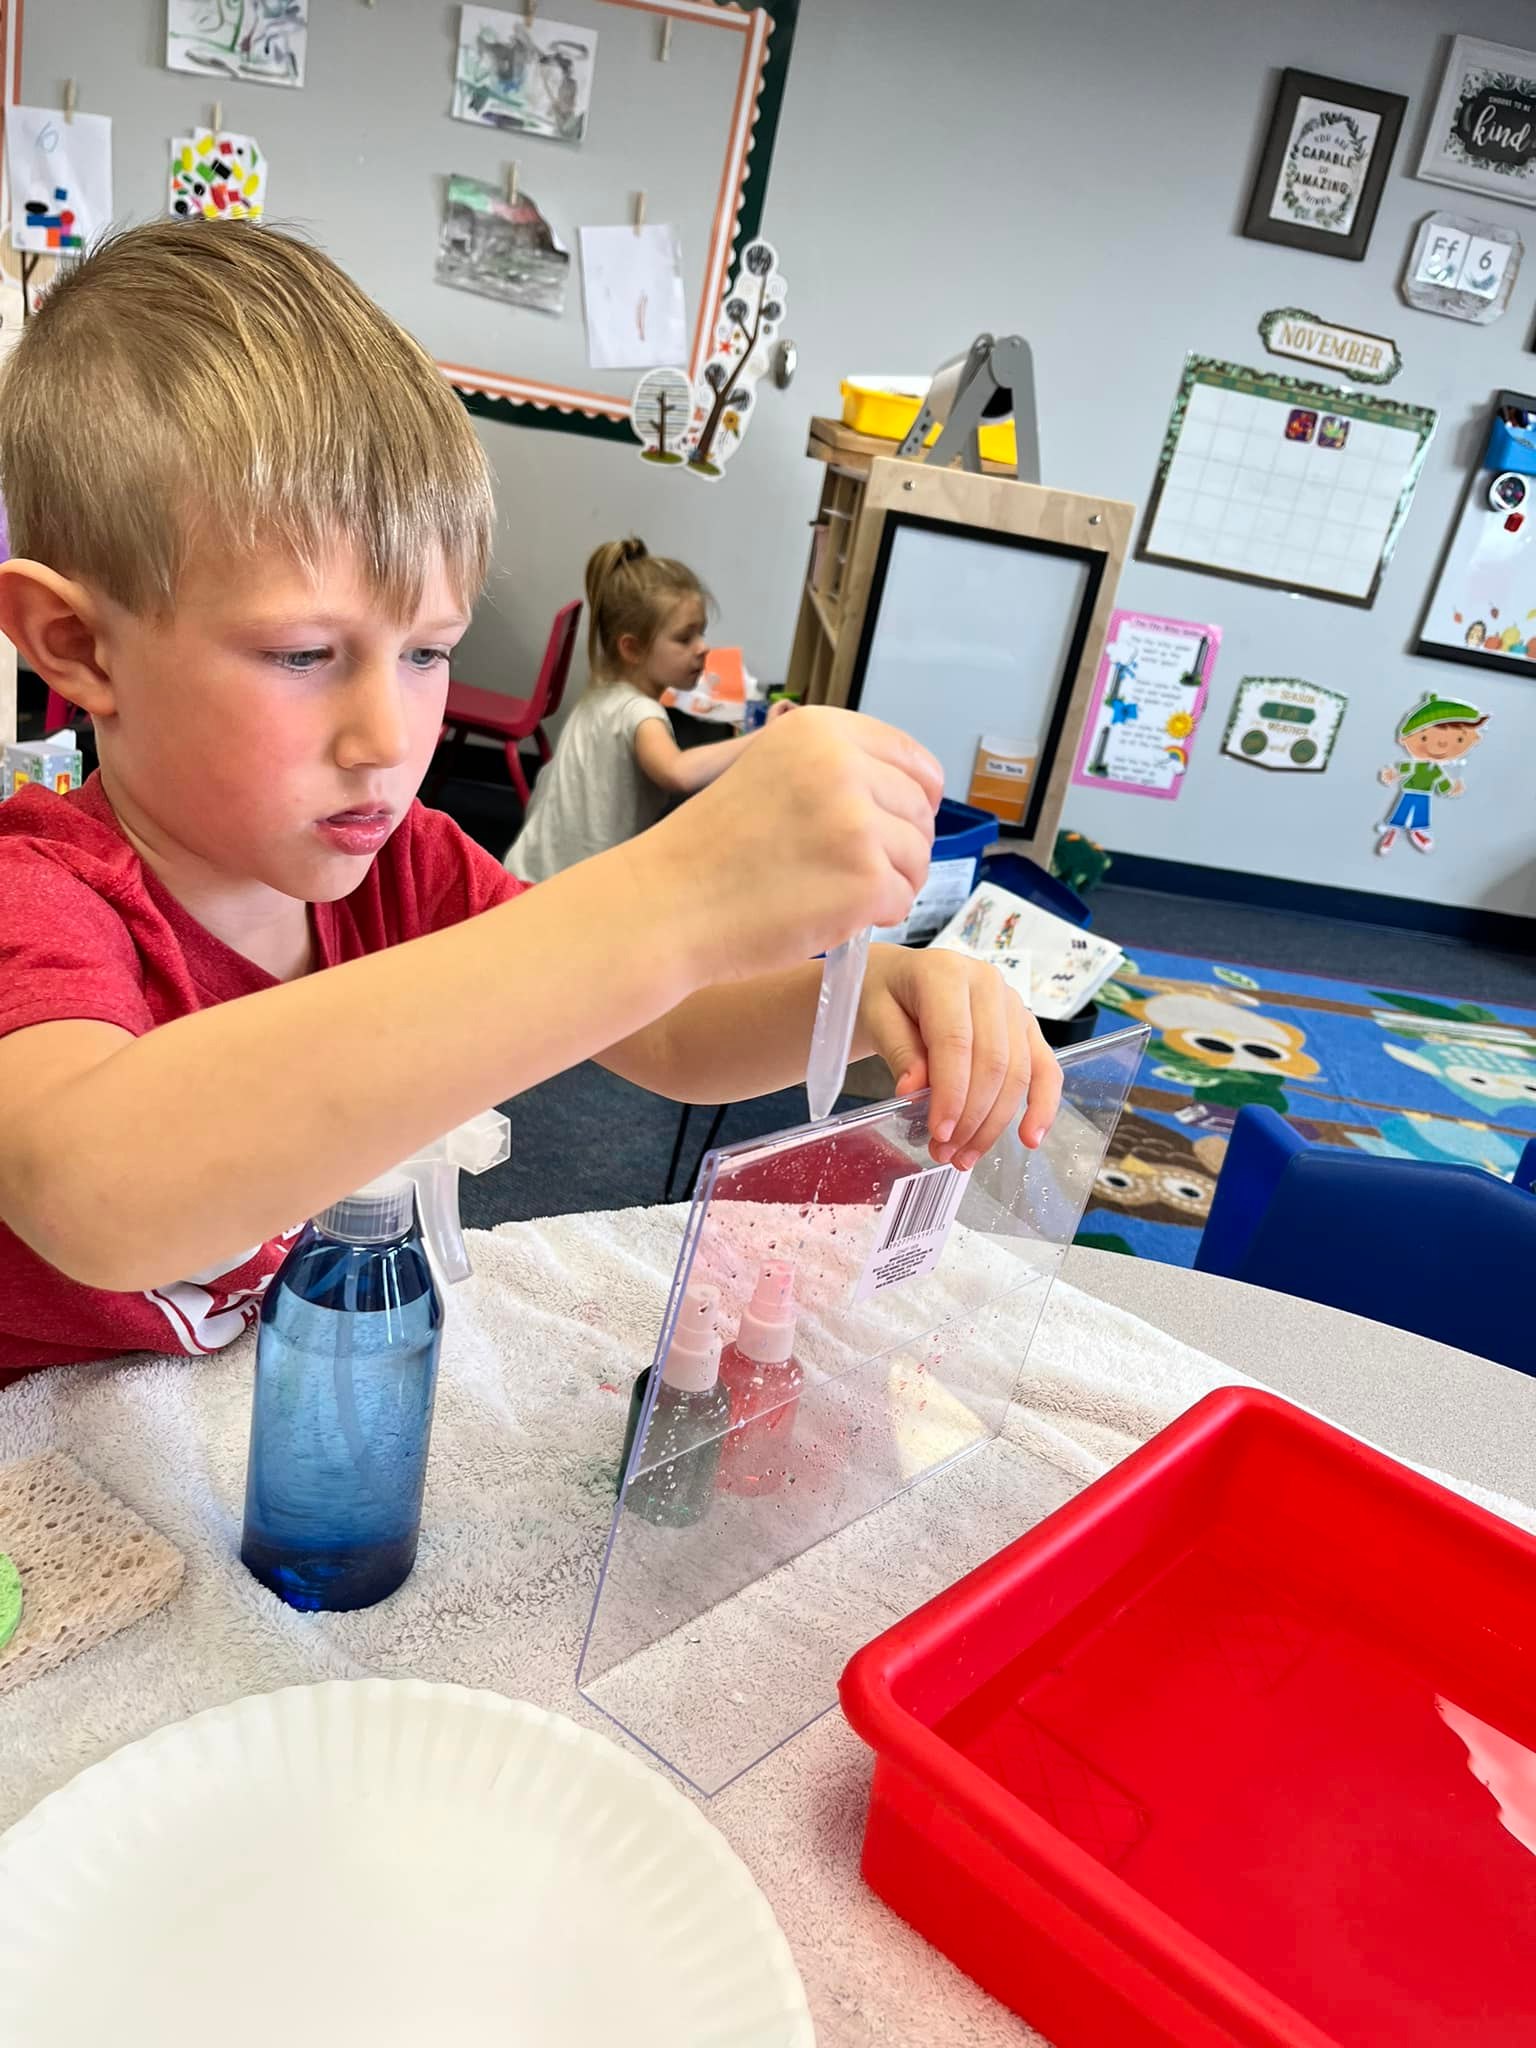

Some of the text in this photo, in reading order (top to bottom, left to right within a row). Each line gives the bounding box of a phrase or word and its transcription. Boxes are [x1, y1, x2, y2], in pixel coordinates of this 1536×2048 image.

[1472, 105, 1531, 152] kind
[1302, 145, 1354, 168] CAPABLE
[1294, 173, 1350, 194] AMAZING
[1430, 236, 1493, 271] Ff 6
[1279, 323, 1384, 370] NOVEMBER
